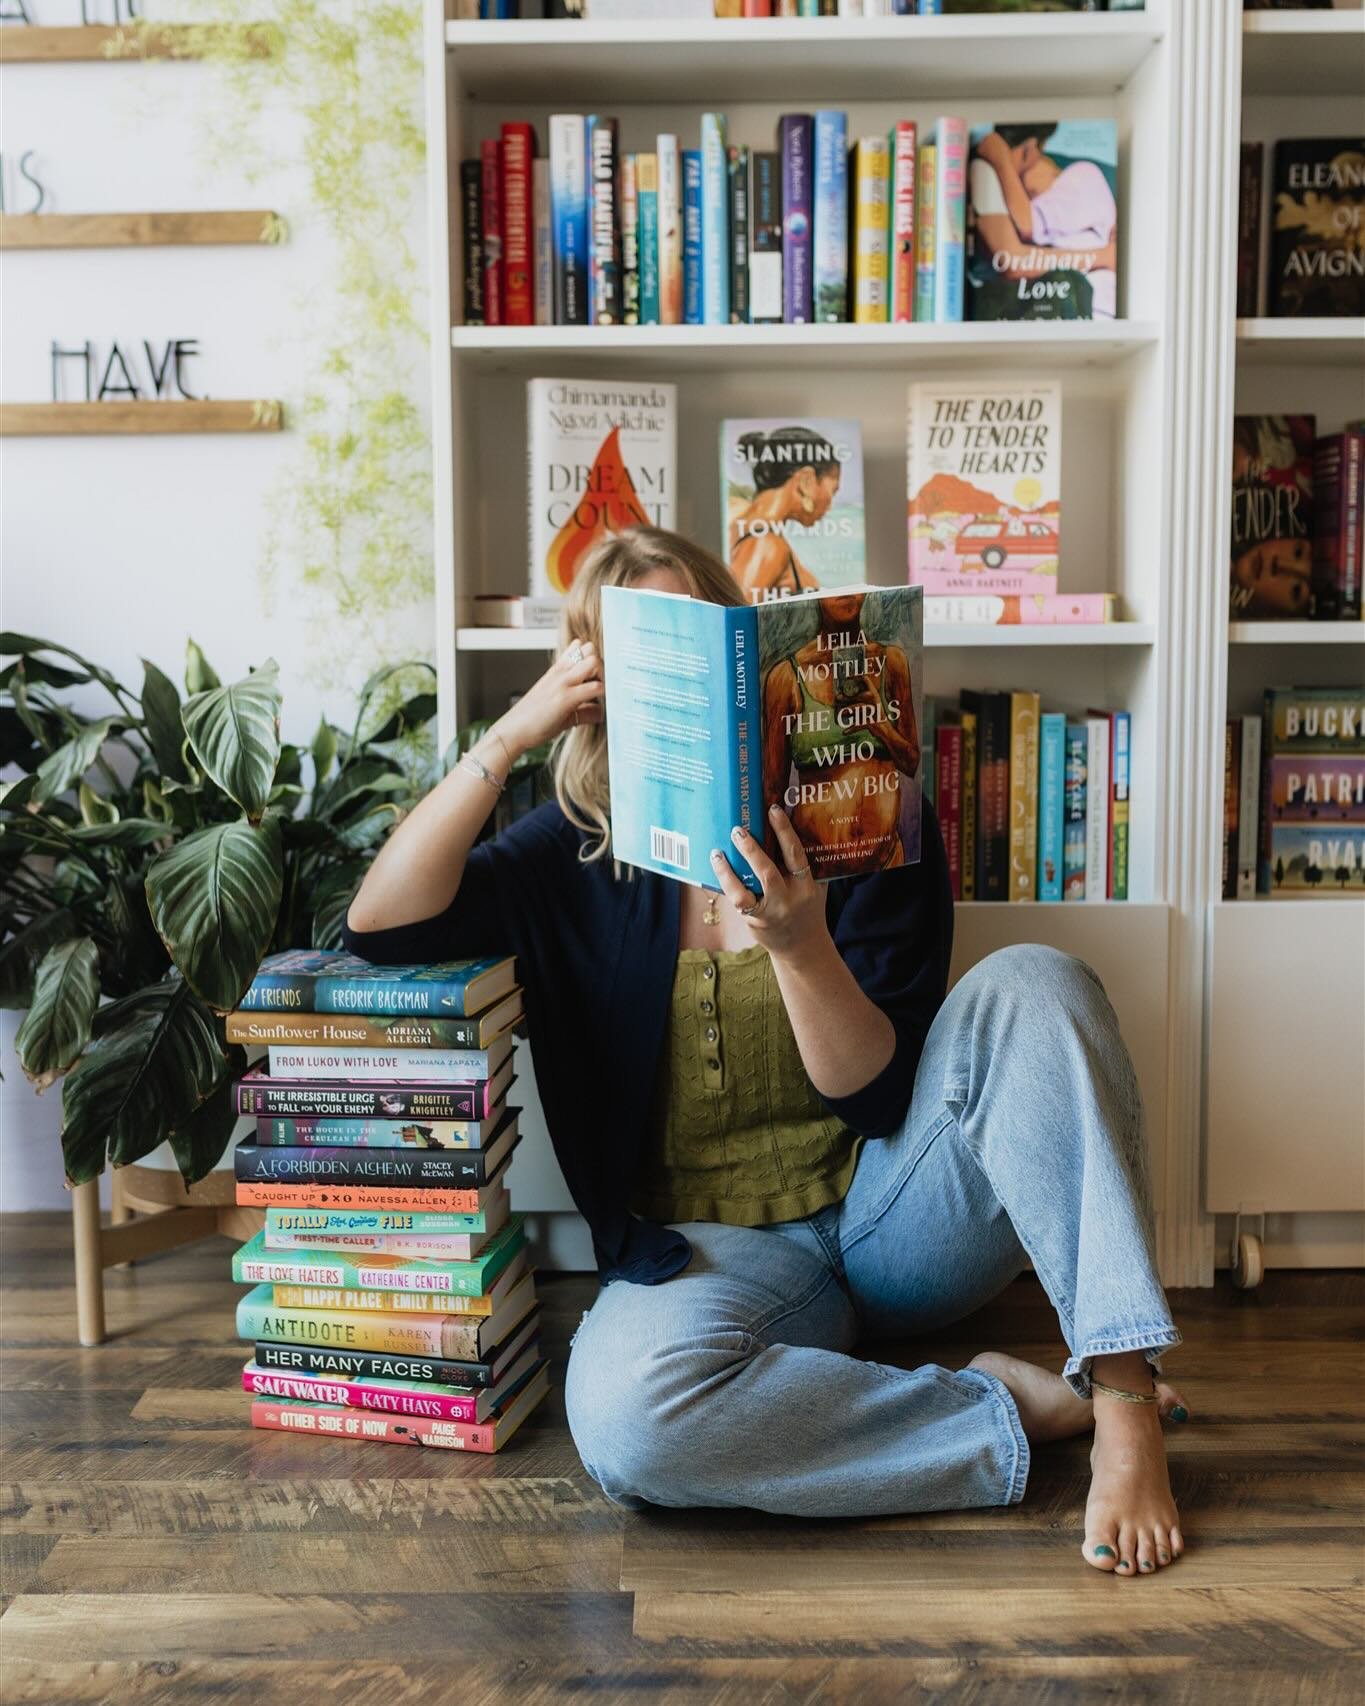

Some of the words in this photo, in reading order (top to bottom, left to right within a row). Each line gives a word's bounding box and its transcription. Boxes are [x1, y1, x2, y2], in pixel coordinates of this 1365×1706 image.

[594, 128, 613, 179] HELLO
[1288, 161, 1365, 189] ELEAN
[505, 173, 526, 263] CONFIDENTIAL
[594, 181, 613, 265] BEAUTIFUL
[1333, 204, 1361, 230] OF
[991, 248, 1097, 274] Ordinary
[1016, 278, 1071, 300] Love
[547, 384, 667, 409] Chimamanda
[549, 410, 599, 434] Ngozi
[601, 412, 665, 432] Adichie
[934, 399, 972, 423] THE
[978, 399, 1044, 423] ROAD
[927, 425, 955, 449] TO
[962, 424, 1049, 449] TENDER
[732, 442, 853, 465] SLANTING
[959, 451, 1048, 474] HEARTS
[547, 463, 667, 495] DREAM
[546, 501, 669, 530] COUNT
[735, 517, 853, 538] TOWARDS
[735, 629, 745, 659] LEILA
[816, 629, 868, 652] LEILA
[797, 655, 887, 684] MOTTLEY
[735, 660, 747, 709] MOTTLEY
[781, 709, 832, 736] THE
[836, 699, 901, 729] GIRLS
[738, 720, 748, 742] THE
[738, 744, 749, 774] GIRLS
[811, 740, 875, 767] WHO
[739, 775, 750, 802] WHO
[784, 779, 859, 807] GREW
[863, 771, 900, 797] BIG
[836, 815, 860, 825] NOVEL
[816, 841, 858, 852] BESTSELLING
[859, 836, 884, 846] AUTHOR
[815, 849, 874, 863] NIGHTCRAWLING
[261, 988, 302, 1007] FRIENDS
[332, 989, 374, 1009] FREDRIK
[377, 991, 429, 1009] BACKMAN
[232, 1028, 247, 1038] The
[248, 1023, 320, 1040] Sunflower
[323, 1025, 367, 1040] House
[384, 1026, 432, 1035] ADRIANA
[386, 1035, 432, 1044] ALLEGRI
[276, 1056, 305, 1067] FROM
[307, 1056, 341, 1067] LUKOV
[343, 1056, 370, 1067] WITH
[372, 1057, 398, 1067] LOVE
[447, 1059, 481, 1067] ZAPATA
[267, 1091, 286, 1101] THE
[287, 1091, 347, 1103] IRRESISTIBLE
[349, 1093, 375, 1104] URGE
[279, 1103, 300, 1113] FALL
[314, 1104, 343, 1114] YOUR
[344, 1105, 375, 1115] ENEMY
[413, 1095, 451, 1105] BRIGITTE
[410, 1106, 454, 1116] KNIGHTLEY
[271, 1159, 350, 1174] FORBIDDEN
[354, 1162, 414, 1176] ALCHEMY
[423, 1162, 452, 1170] STACEY
[255, 1193, 298, 1201] CAUGHT
[358, 1196, 410, 1204] NAVESSA
[412, 1197, 447, 1205] ALLEN
[277, 1215, 329, 1230] TOTALLY
[381, 1216, 413, 1230] FINE
[293, 1234, 341, 1243] FIRST-TIME
[343, 1237, 375, 1246] CALLER
[416, 1242, 453, 1250] BORISON
[247, 1264, 265, 1281] THE
[268, 1265, 294, 1281] LOVE
[298, 1267, 340, 1284] HATERS
[361, 1271, 410, 1289] KATHERINE
[415, 1274, 450, 1290] CENTER
[303, 1288, 341, 1307] HAPPY
[344, 1290, 382, 1309] PLACE
[393, 1294, 429, 1310] EMILY
[432, 1296, 470, 1311] HENRY
[262, 1316, 356, 1344] ANTIDOTE
[388, 1327, 432, 1340] KAREN
[384, 1340, 439, 1353] RUSSELL
[265, 1350, 303, 1367] HER
[310, 1353, 365, 1372] MANY
[371, 1359, 433, 1378] FACES
[441, 1367, 467, 1375] NICCI
[251, 1374, 350, 1406] SALTWATER
[361, 1391, 400, 1410] KATY
[402, 1395, 443, 1416] HAYS
[280, 1412, 316, 1429] OTHER
[318, 1415, 343, 1432] SIDE
[345, 1418, 360, 1434] OF
[362, 1419, 388, 1437] NOW
[431, 1422, 457, 1436] PAIGE
